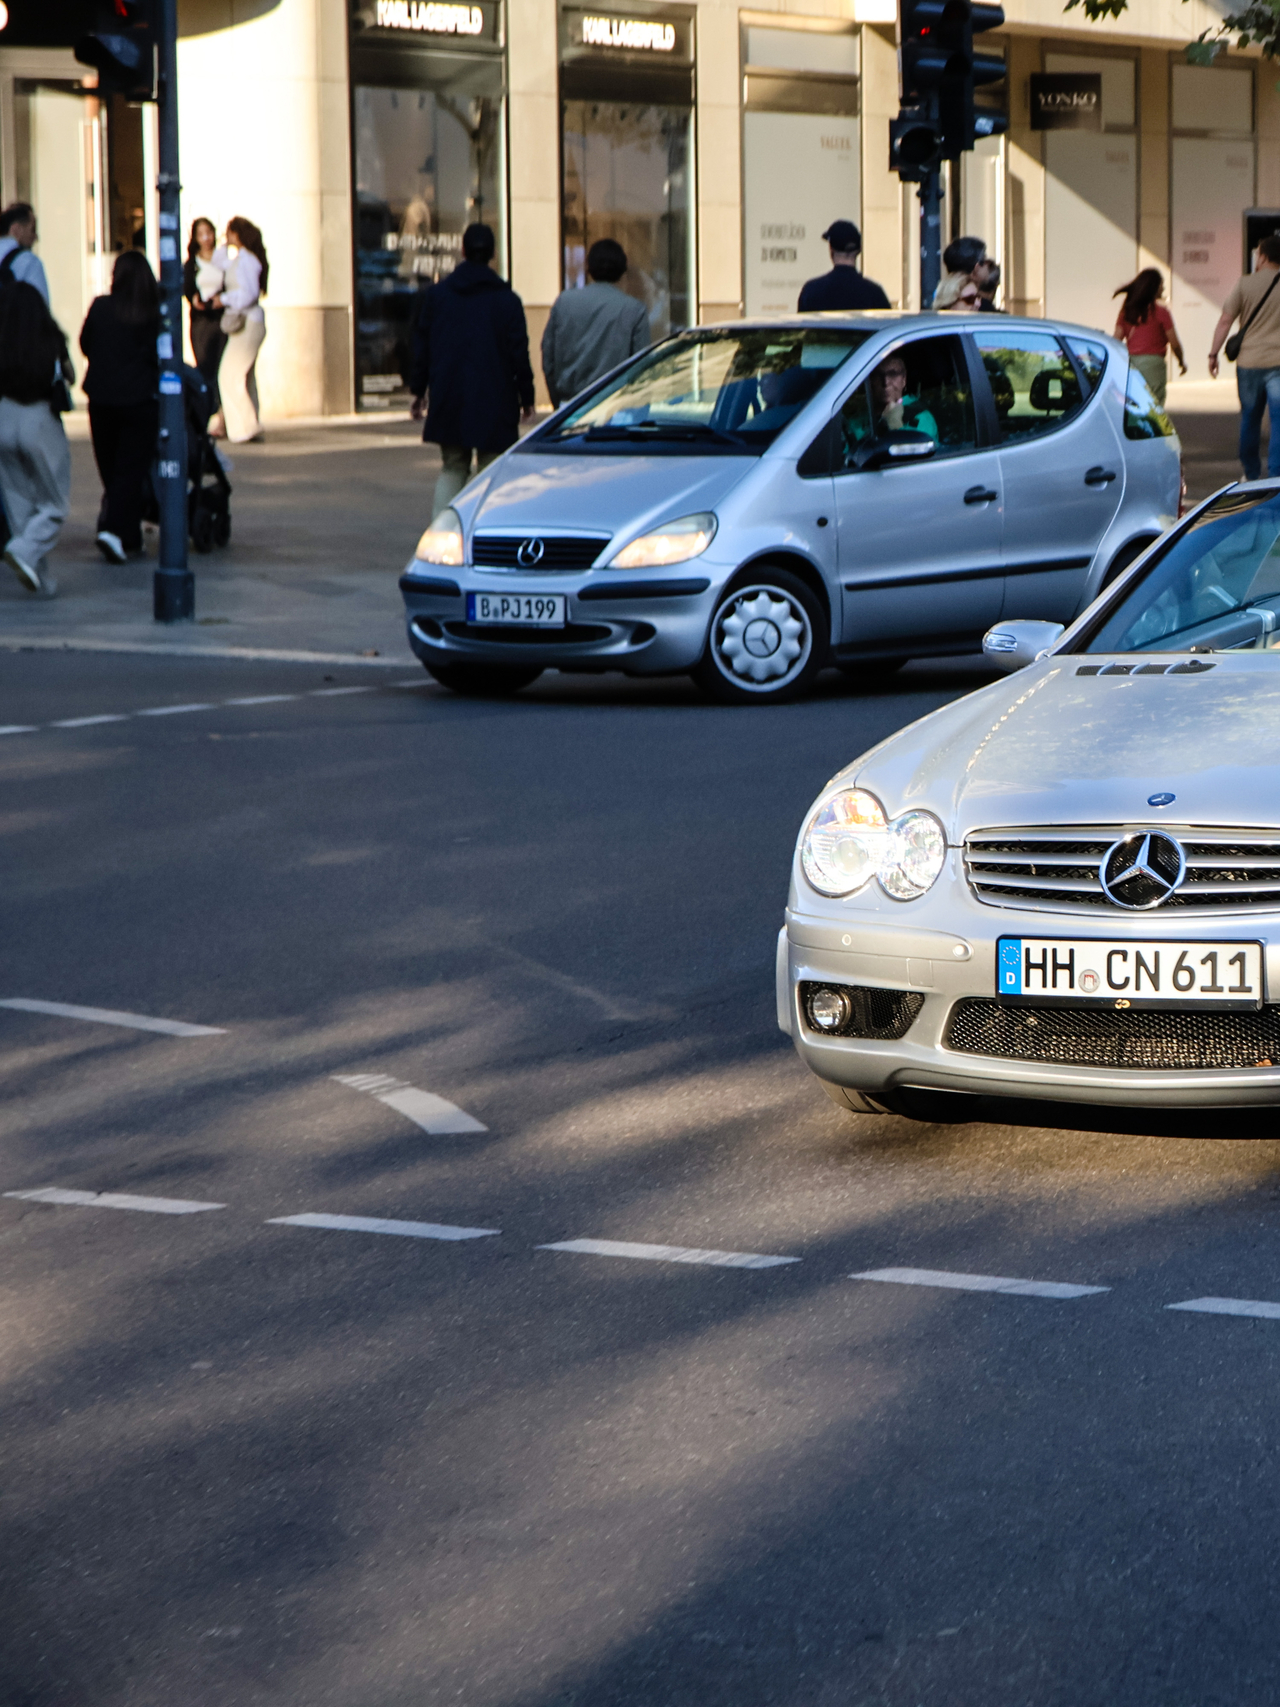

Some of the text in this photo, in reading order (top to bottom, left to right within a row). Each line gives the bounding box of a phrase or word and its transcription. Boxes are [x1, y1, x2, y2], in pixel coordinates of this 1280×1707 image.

[583, 16, 676, 51] KARL LAGERFELD
[1039, 92, 1097, 106] YONKO
[481, 598, 556, 620] B PJ 199
[1006, 972, 1016, 985] D
[1025, 947, 1252, 993] HH CN 611
